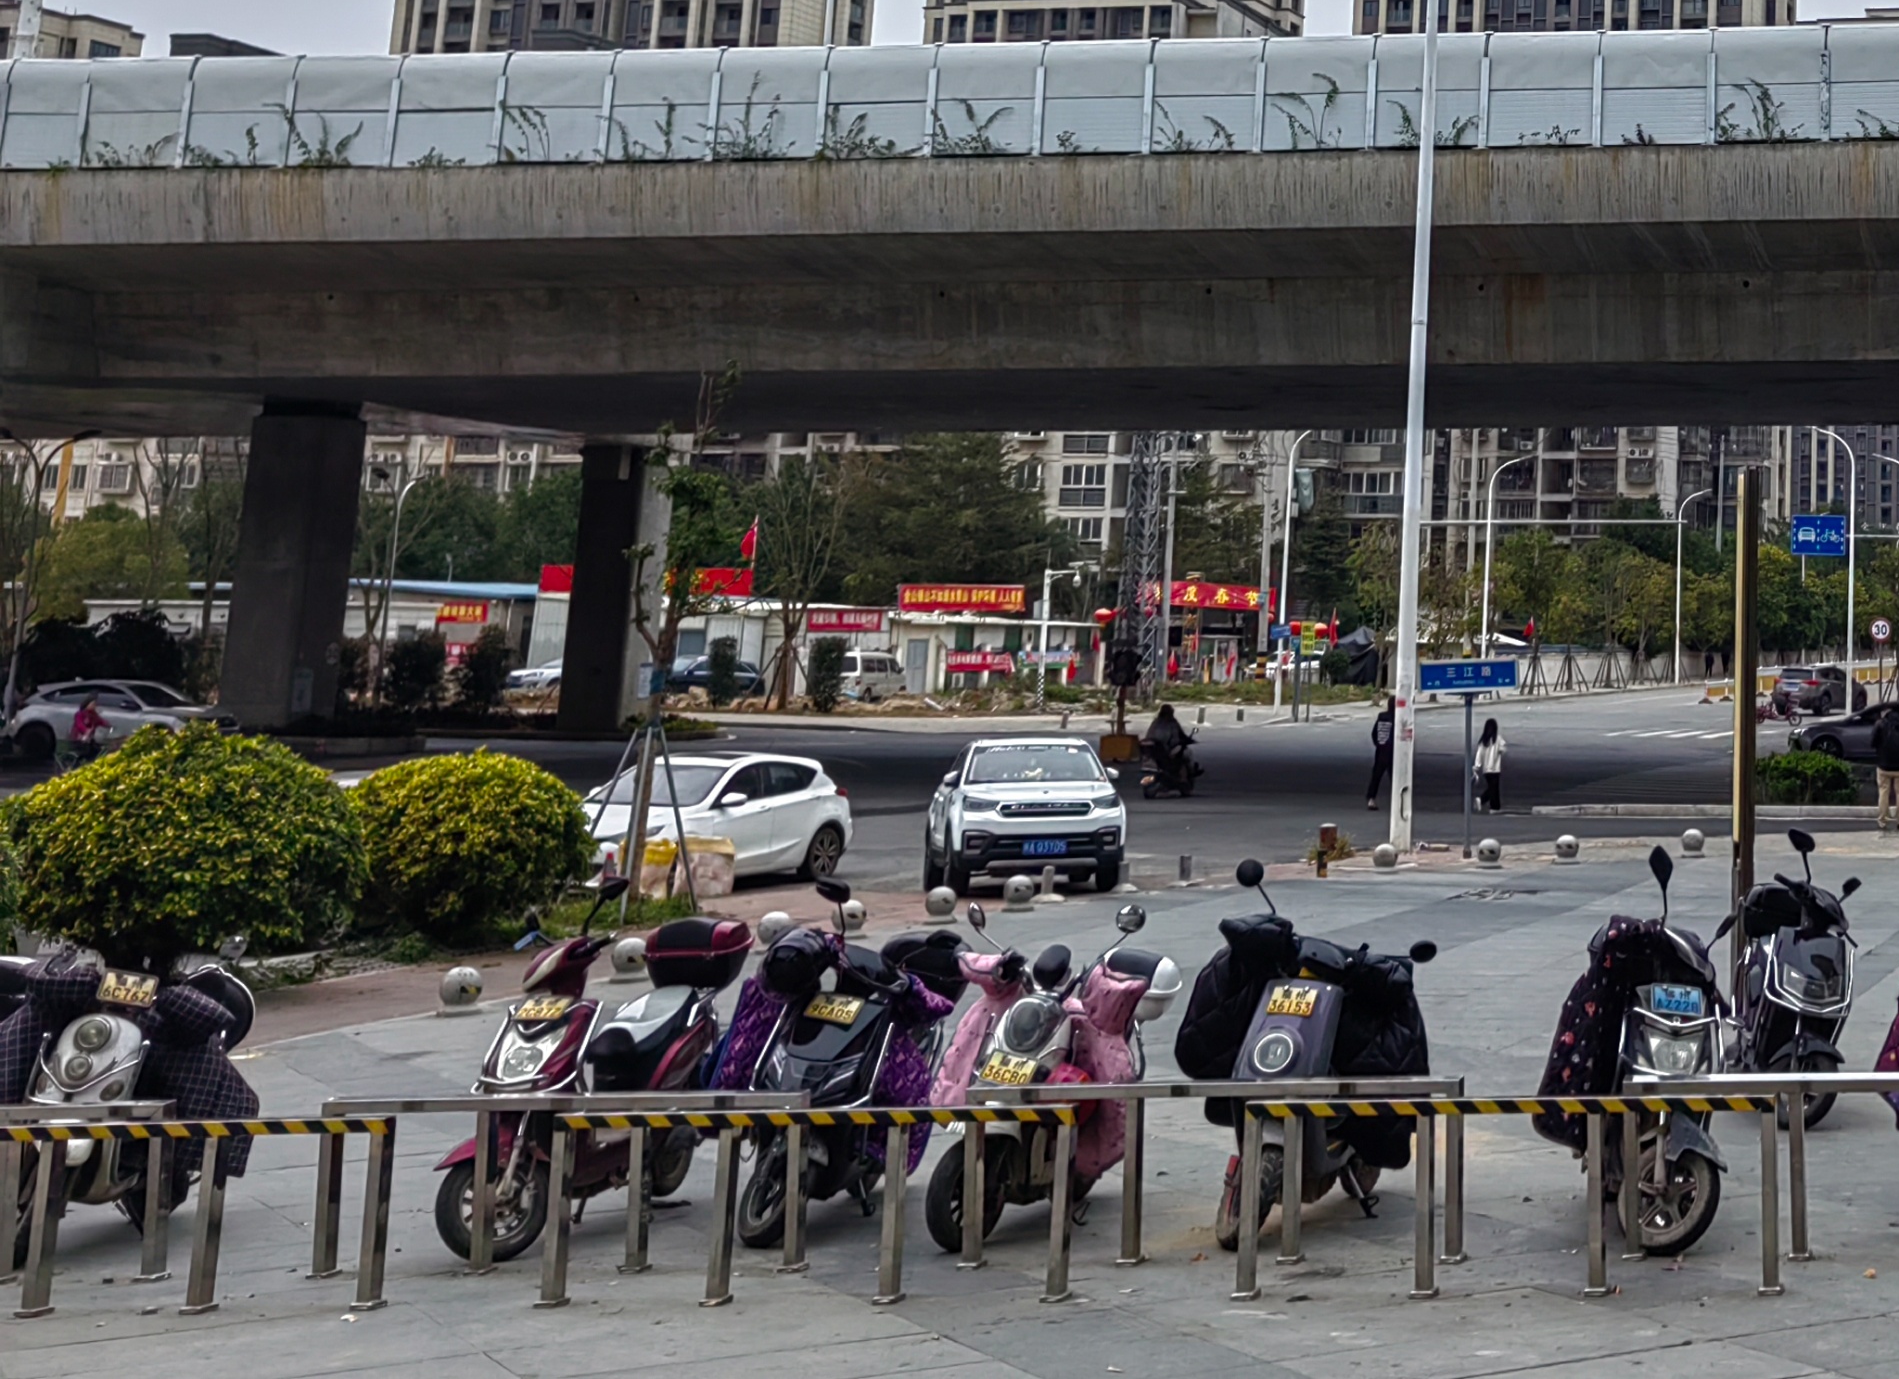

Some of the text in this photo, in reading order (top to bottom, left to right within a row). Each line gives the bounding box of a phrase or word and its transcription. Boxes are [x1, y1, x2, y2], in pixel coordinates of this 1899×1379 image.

[1874, 624, 1888, 636] 30
[1446, 666, 1491, 677] 三江路
[102, 986, 150, 1003] 6C767
[1268, 999, 1311, 1014] 36153
